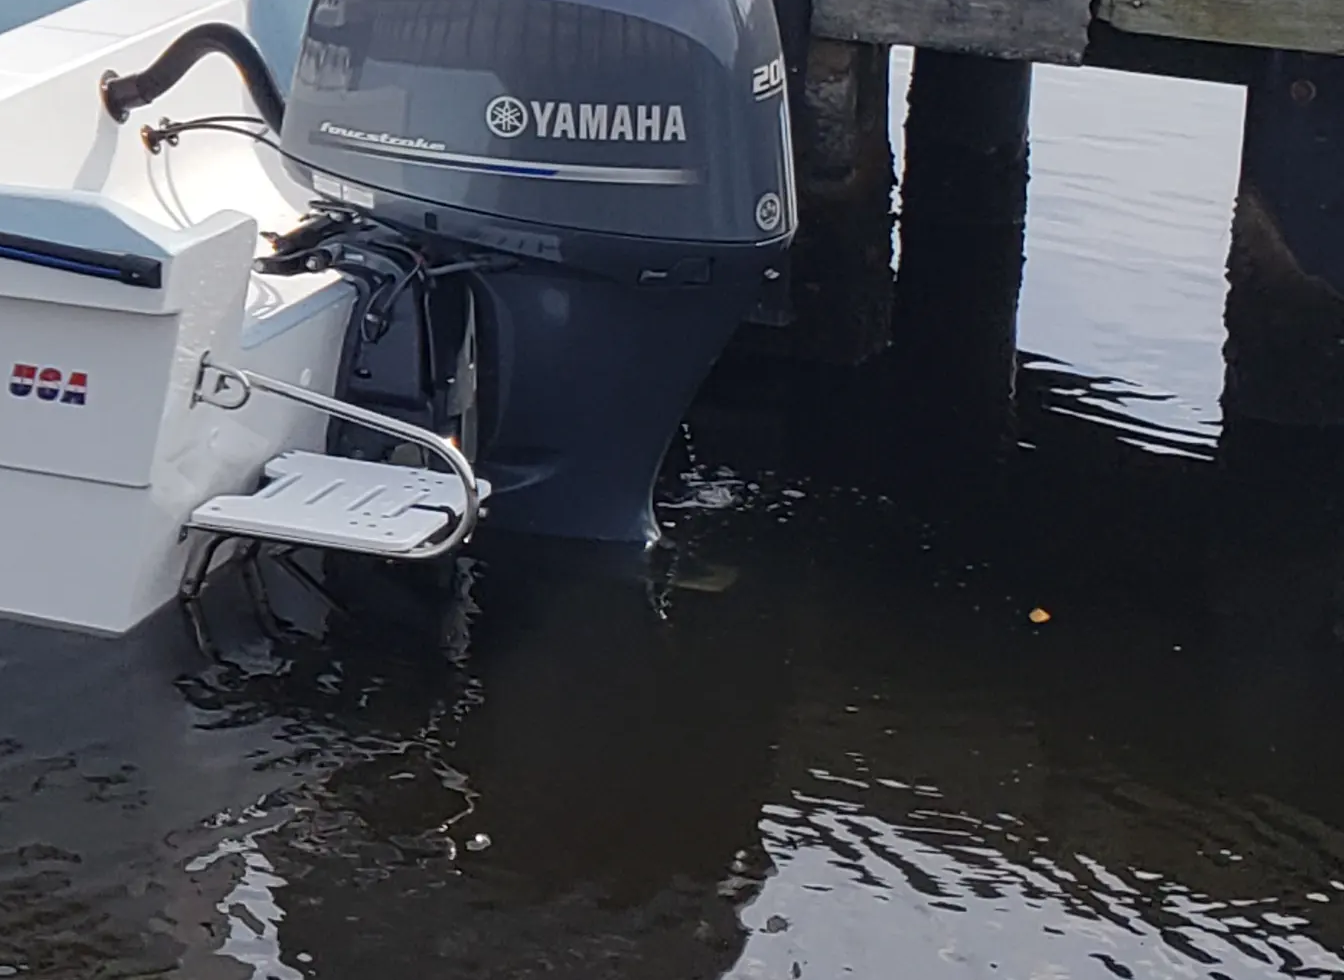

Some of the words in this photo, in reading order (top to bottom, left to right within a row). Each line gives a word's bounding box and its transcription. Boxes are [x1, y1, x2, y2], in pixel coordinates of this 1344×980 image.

[752, 58, 784, 93] 20
[530, 100, 687, 142] YAMAHA
[8, 363, 89, 407] USA
